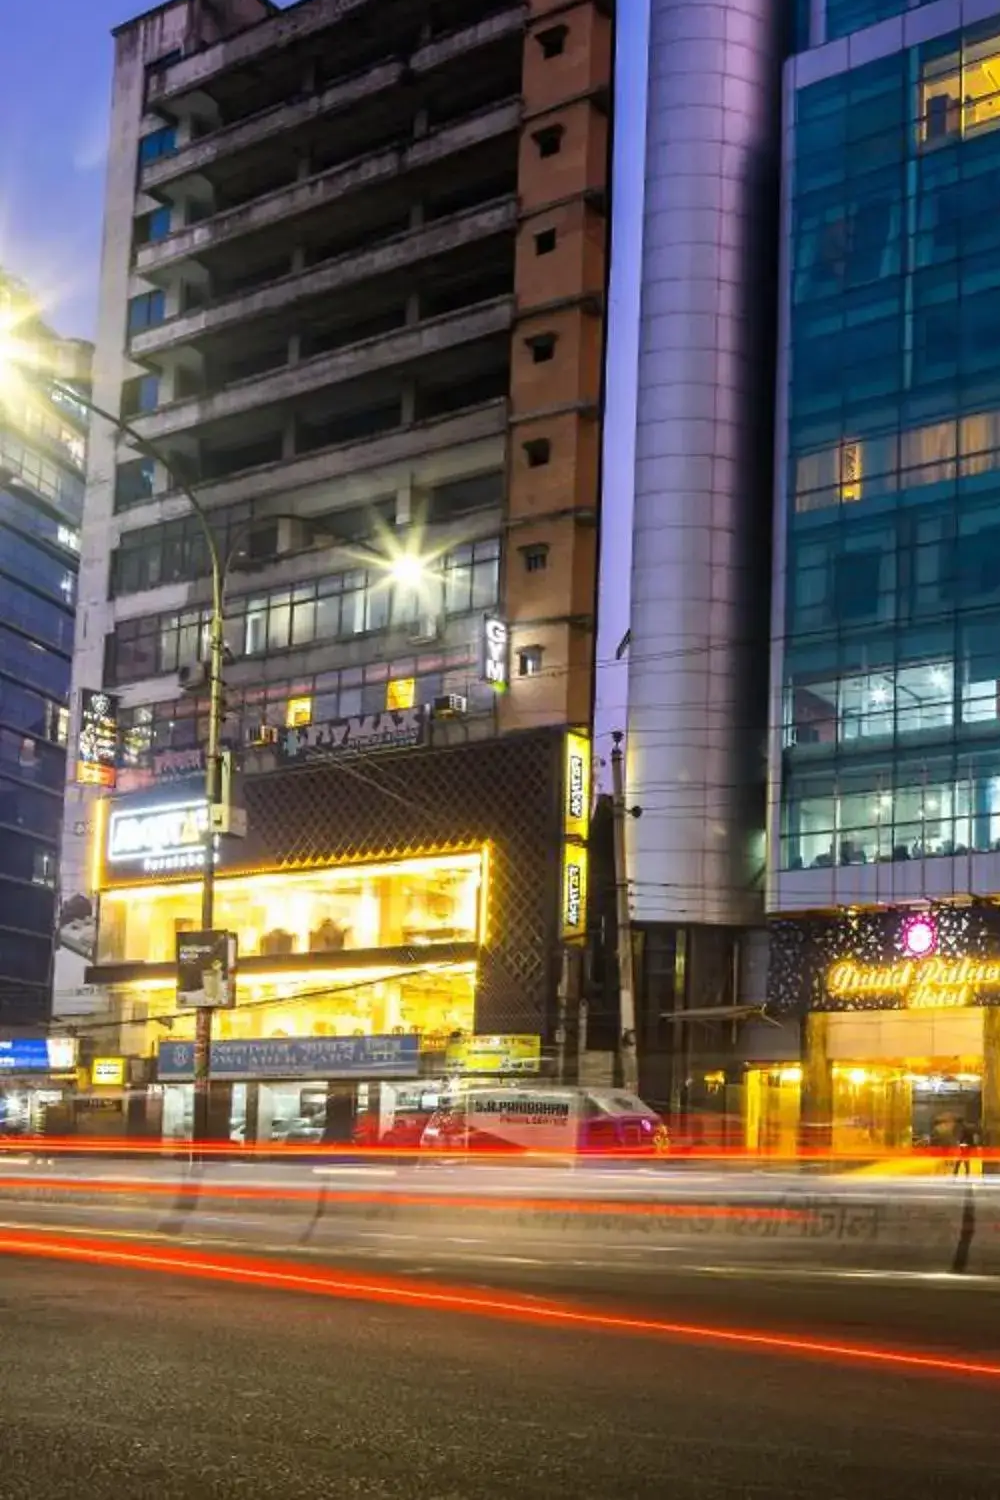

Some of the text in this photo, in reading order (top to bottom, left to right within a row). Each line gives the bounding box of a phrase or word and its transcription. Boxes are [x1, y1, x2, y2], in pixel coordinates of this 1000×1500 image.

[486, 620, 506, 682] GYM
[833, 960, 912, 990] Grand
[911, 984, 968, 1008] Hotel
